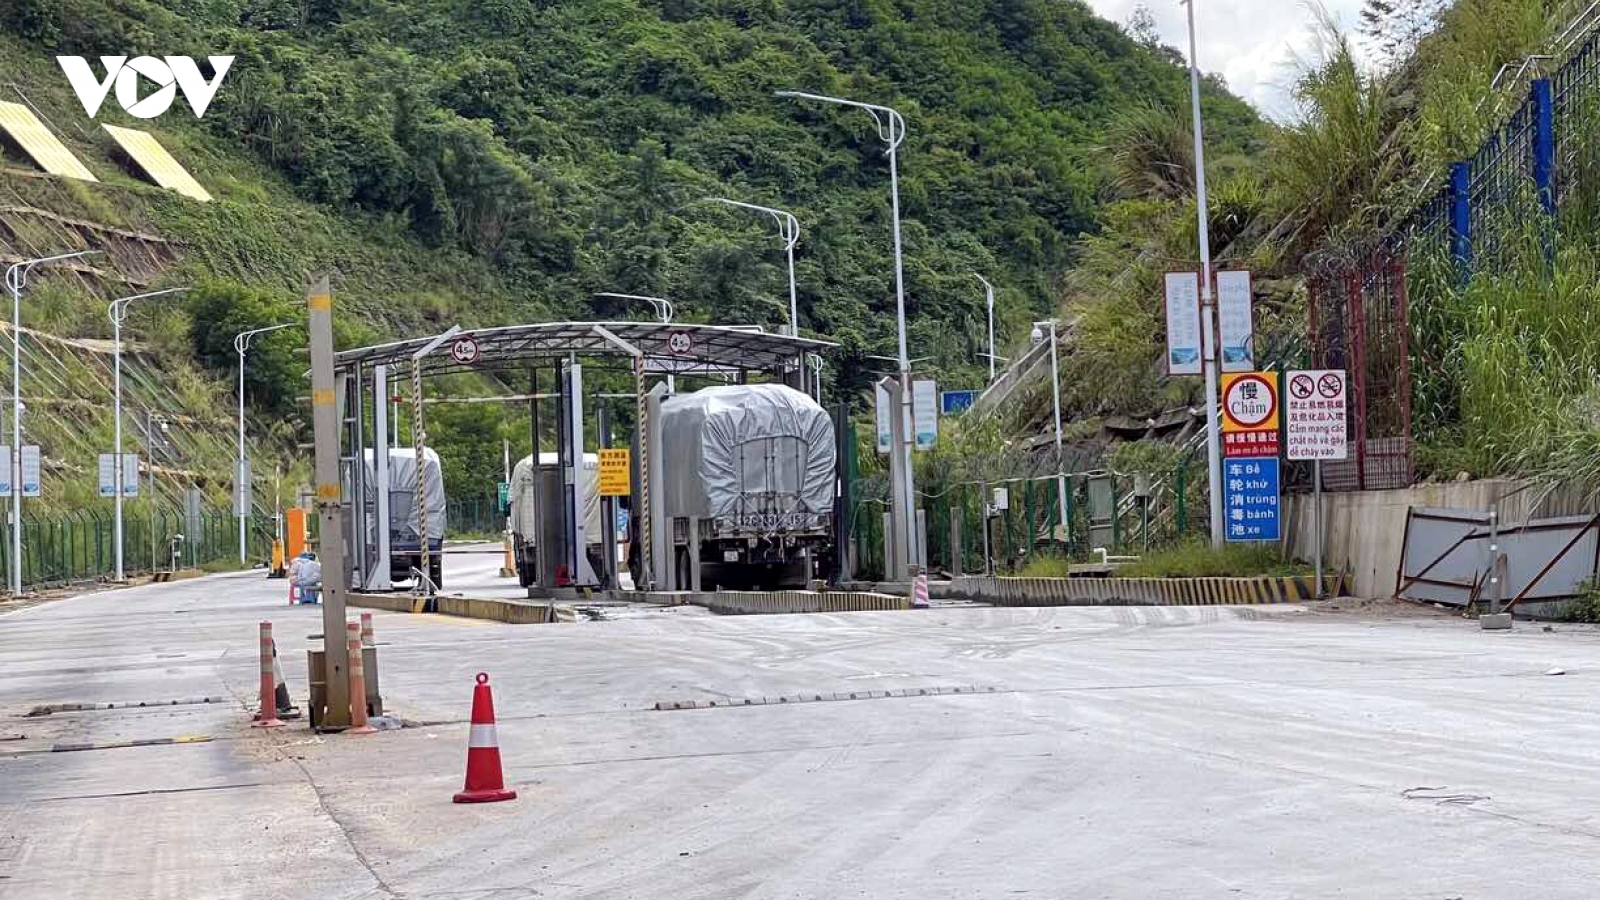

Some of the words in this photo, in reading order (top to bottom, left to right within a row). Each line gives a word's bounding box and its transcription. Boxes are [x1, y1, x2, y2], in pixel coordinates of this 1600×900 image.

[1239, 382, 1258, 400] 慢
[1231, 401, 1267, 417] Chậm
[1247, 525, 1260, 534] xe
